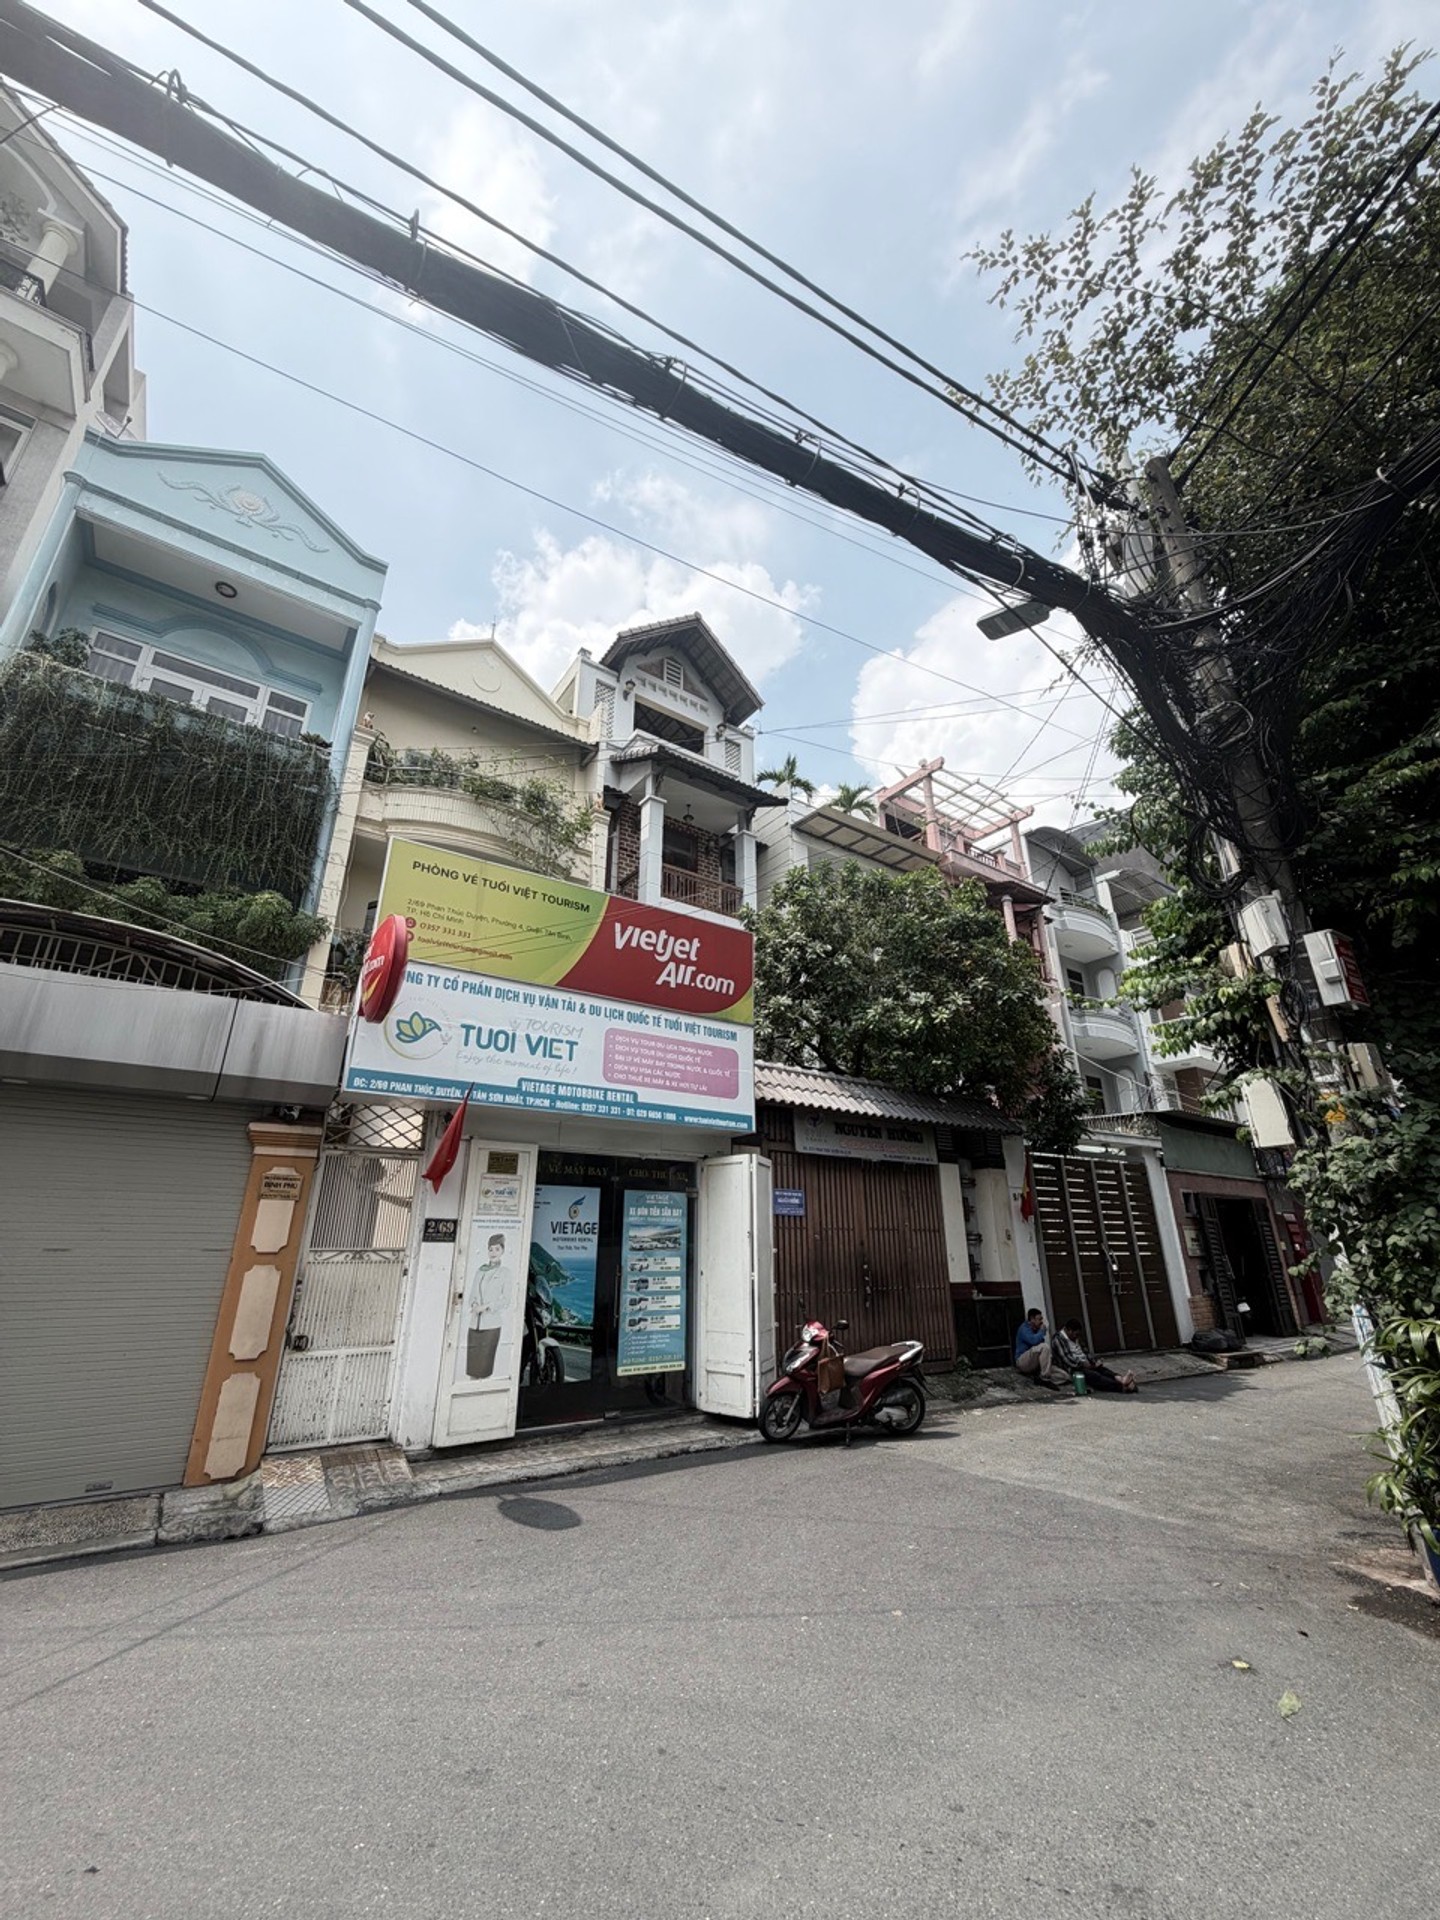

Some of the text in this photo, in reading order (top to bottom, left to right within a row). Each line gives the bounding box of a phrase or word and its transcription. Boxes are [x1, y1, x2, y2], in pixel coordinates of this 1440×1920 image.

[407, 898, 426, 908] 2/69
[426, 902, 445, 912] Phan
[513, 885, 538, 901] VIỆT
[540, 892, 591, 913] TOURISM
[446, 915, 465, 925] Minh
[442, 926, 456, 936] 331
[457, 930, 471, 939] 331
[614, 922, 701, 963] Vietjet
[656, 961, 735, 995] Air.com
[405, 970, 423, 985] NG
[427, 973, 441, 989] TY
[494, 986, 521, 1004] DỊCH
[522, 992, 537, 1007] VỤ
[579, 1003, 586, 1014] &
[589, 1004, 602, 1016] DU
[604, 1007, 625, 1022] LỊCH
[626, 1009, 650, 1026] QUỐC
[652, 1014, 664, 1028] TẾ
[684, 1021, 702, 1037] VIỆT
[703, 1027, 738, 1042] TOURISM
[525, 1018, 584, 1038] TOURISM
[390, 1081, 413, 1093] PHAN
[521, 1081, 635, 1104] VIETAGE MOTORBIKE RENTAL
[427, 1220, 455, 1233] 2/69
[551, 1221, 598, 1235] VIETAGE
